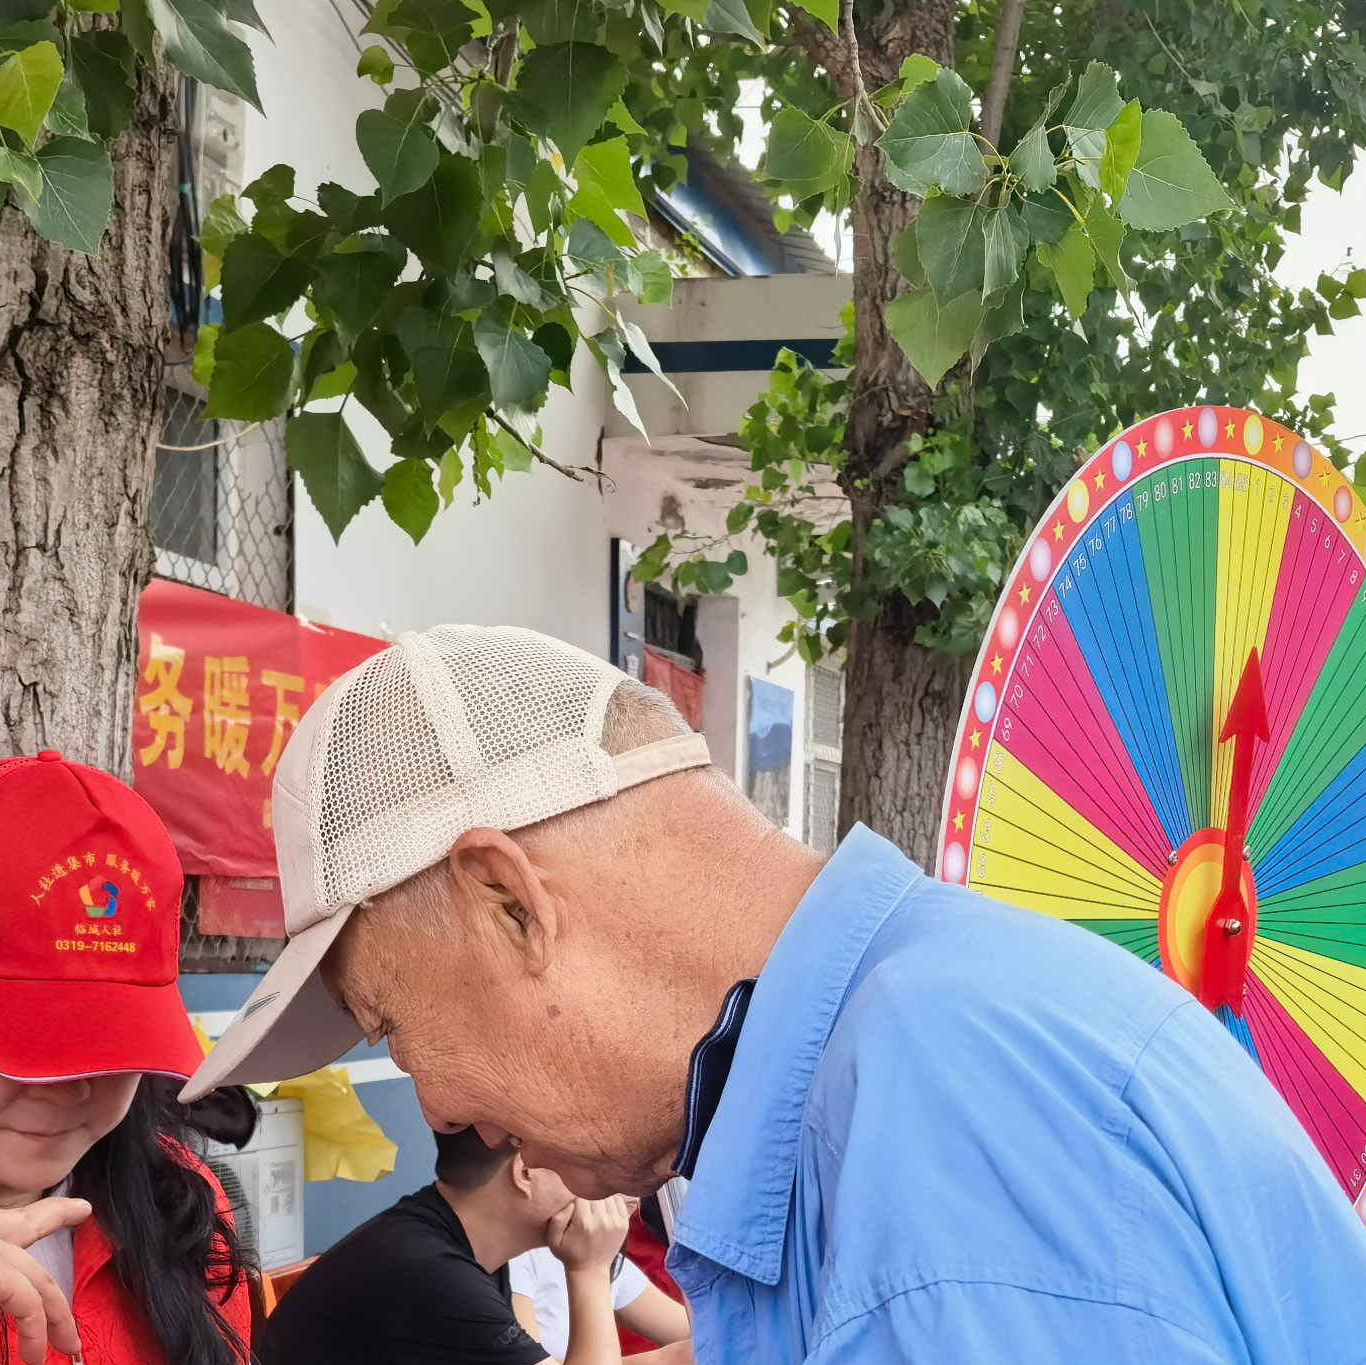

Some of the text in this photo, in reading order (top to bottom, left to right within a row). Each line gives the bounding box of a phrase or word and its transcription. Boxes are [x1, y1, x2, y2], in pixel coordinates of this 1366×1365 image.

[1172, 475, 1183, 494] 81
[1189, 472, 1201, 489] 82
[1205, 471, 1217, 487] 83
[1136, 491, 1149, 511] 79
[1154, 482, 1167, 501] 80
[1120, 503, 1133, 524] 78
[1295, 505, 1302, 518] 4
[1104, 516, 1116, 539] 77
[1310, 518, 1318, 533] 5
[1089, 534, 1103, 557] 76
[1324, 534, 1332, 549] 6
[1073, 553, 1086, 577] 75
[1337, 549, 1346, 563] 7
[1059, 575, 1072, 599] 74
[1350, 570, 1358, 584] 8
[1045, 599, 1059, 624] 73
[1033, 625, 1046, 650] 72
[1021, 655, 1034, 678] 71
[138, 632, 335, 780] 务暖万
[1010, 684, 1024, 709] 70
[1001, 717, 1013, 742] 69
[30, 852, 96, 906] 人社进集市
[74, 923, 124, 936] 临城人社
[56, 939, 136, 953] 0319-7162448
[1350, 1169, 1362, 1187] 31
